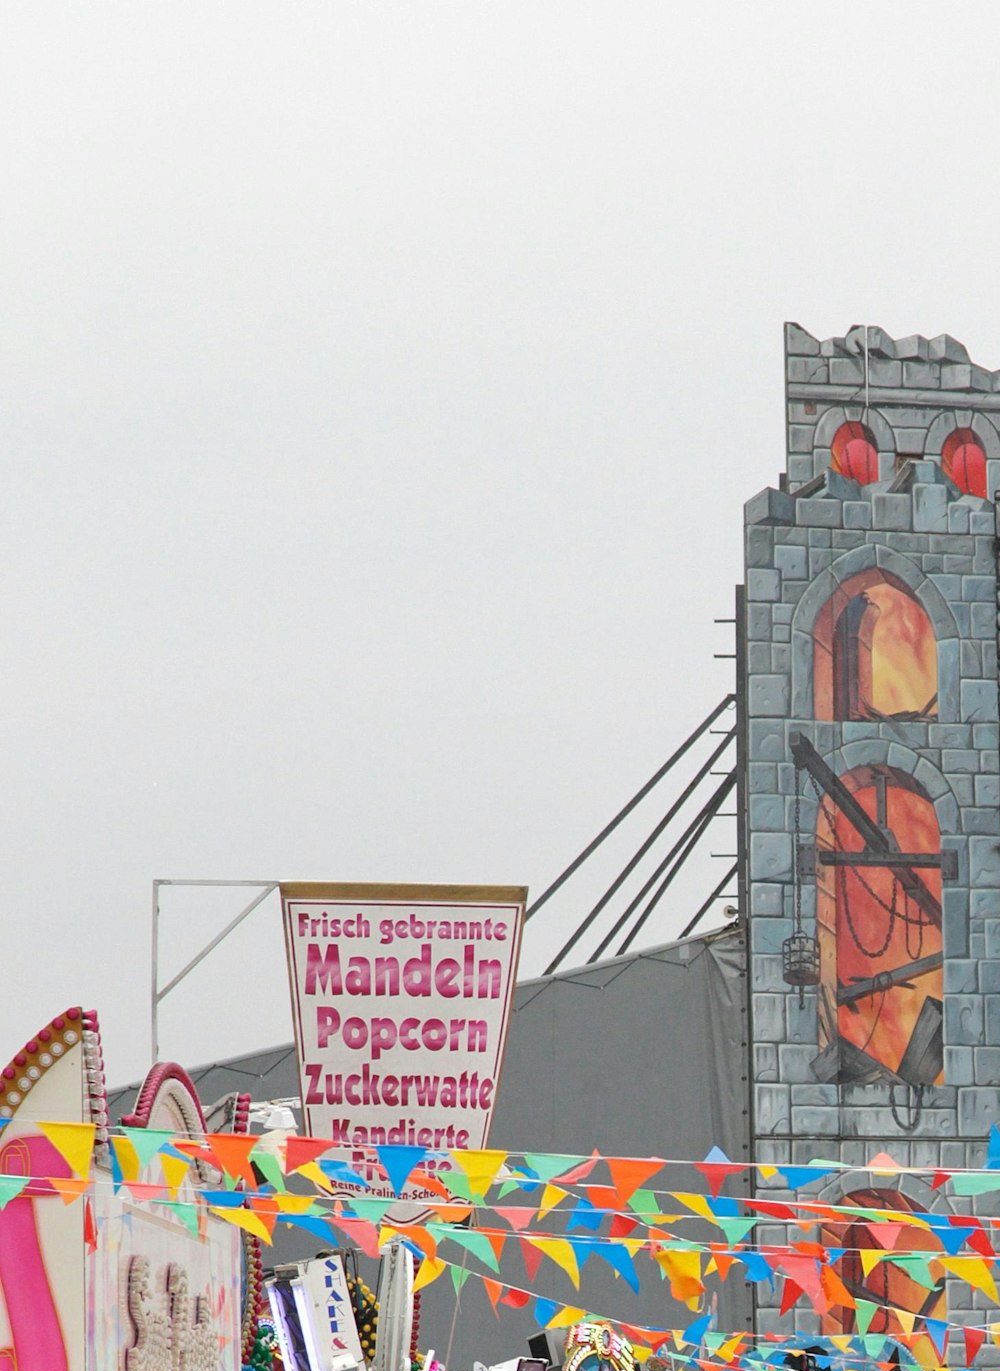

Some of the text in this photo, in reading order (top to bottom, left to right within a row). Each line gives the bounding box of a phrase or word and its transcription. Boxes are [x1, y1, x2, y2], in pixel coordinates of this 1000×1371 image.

[298, 912, 508, 944] Frisch gebrannte
[304, 943, 502, 999] Mandeln
[316, 1006, 488, 1060] Popcorn
[305, 1063, 494, 1110] Zuckerwatte
[331, 1180, 366, 1192] Reine
[324, 1259, 346, 1334] SHAKE
